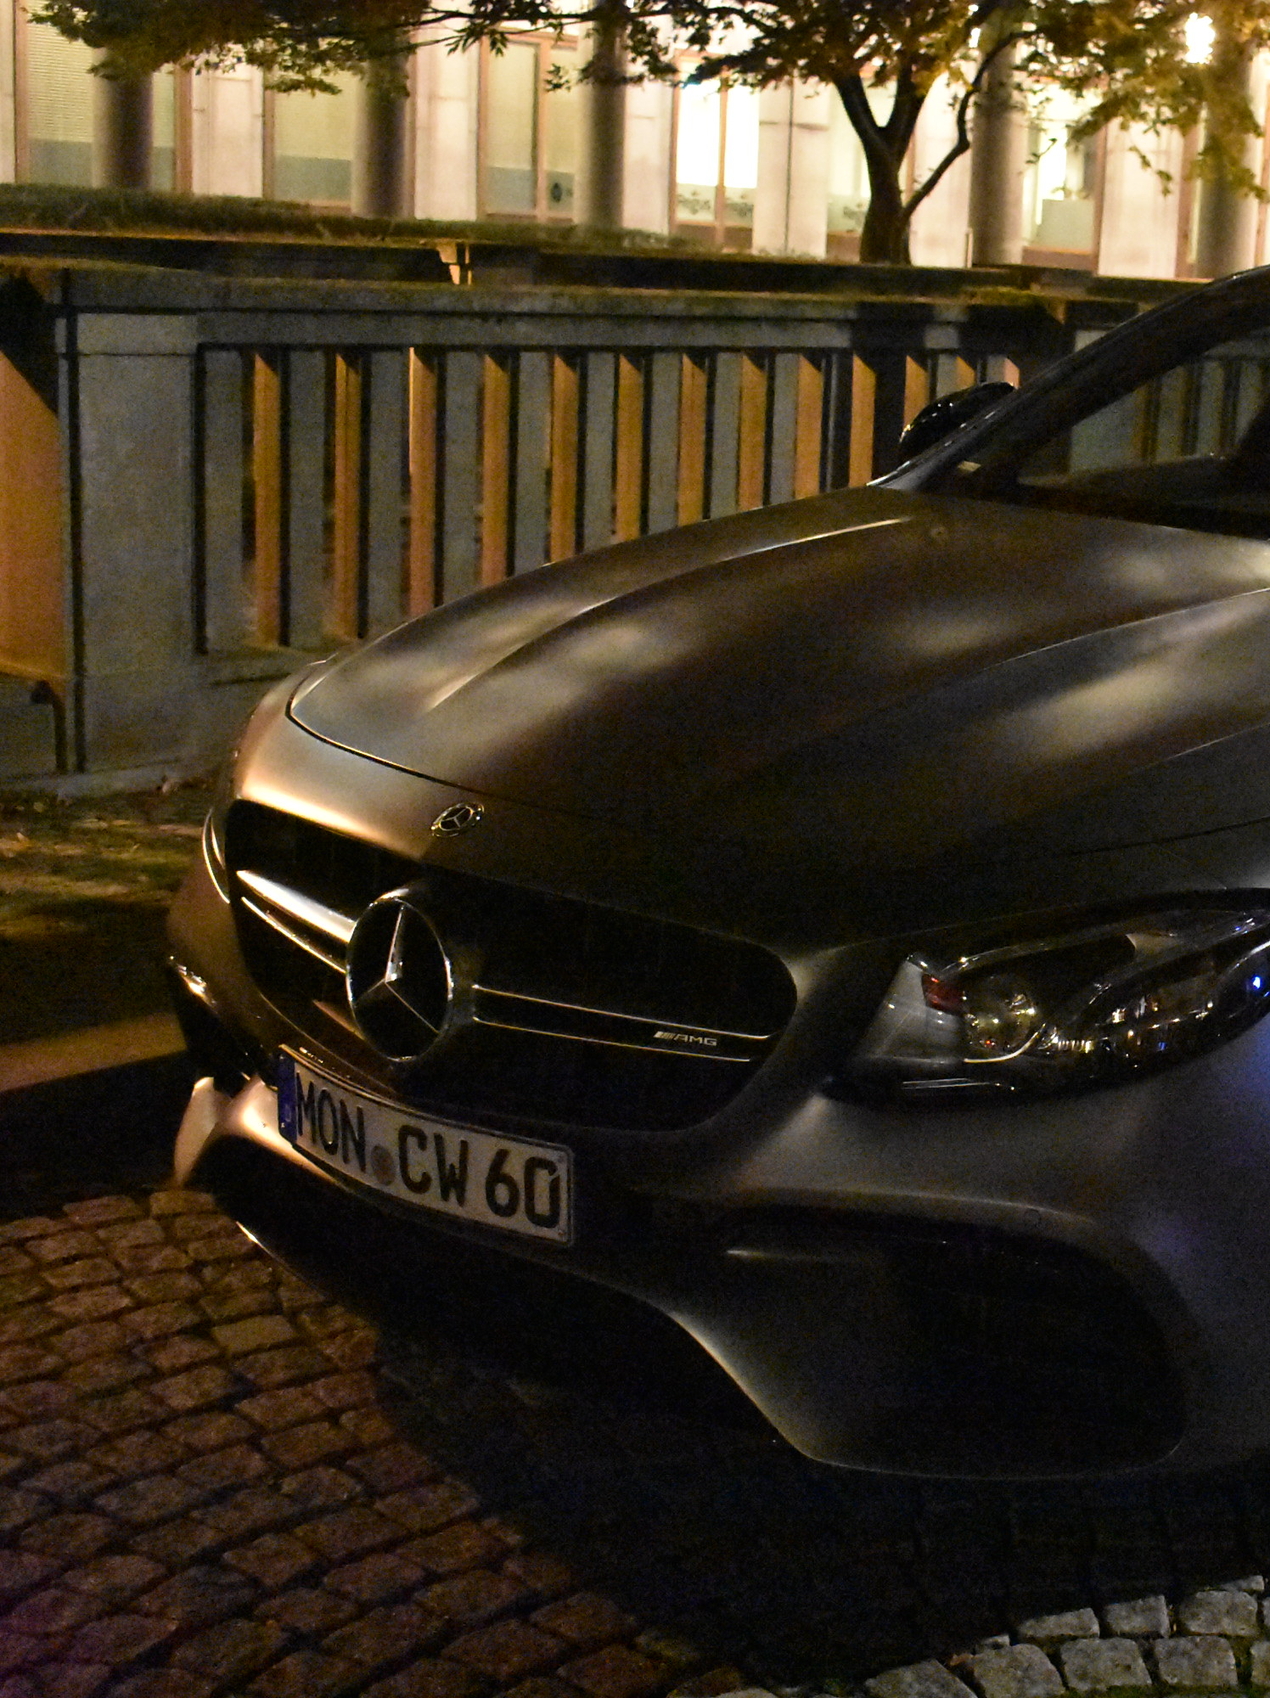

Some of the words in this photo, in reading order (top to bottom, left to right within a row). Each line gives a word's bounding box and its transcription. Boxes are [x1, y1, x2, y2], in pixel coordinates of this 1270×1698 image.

[672, 1032, 718, 1047] AMG
[295, 1071, 367, 1174] MON
[398, 1124, 469, 1208] CW
[484, 1148, 561, 1229] 60
